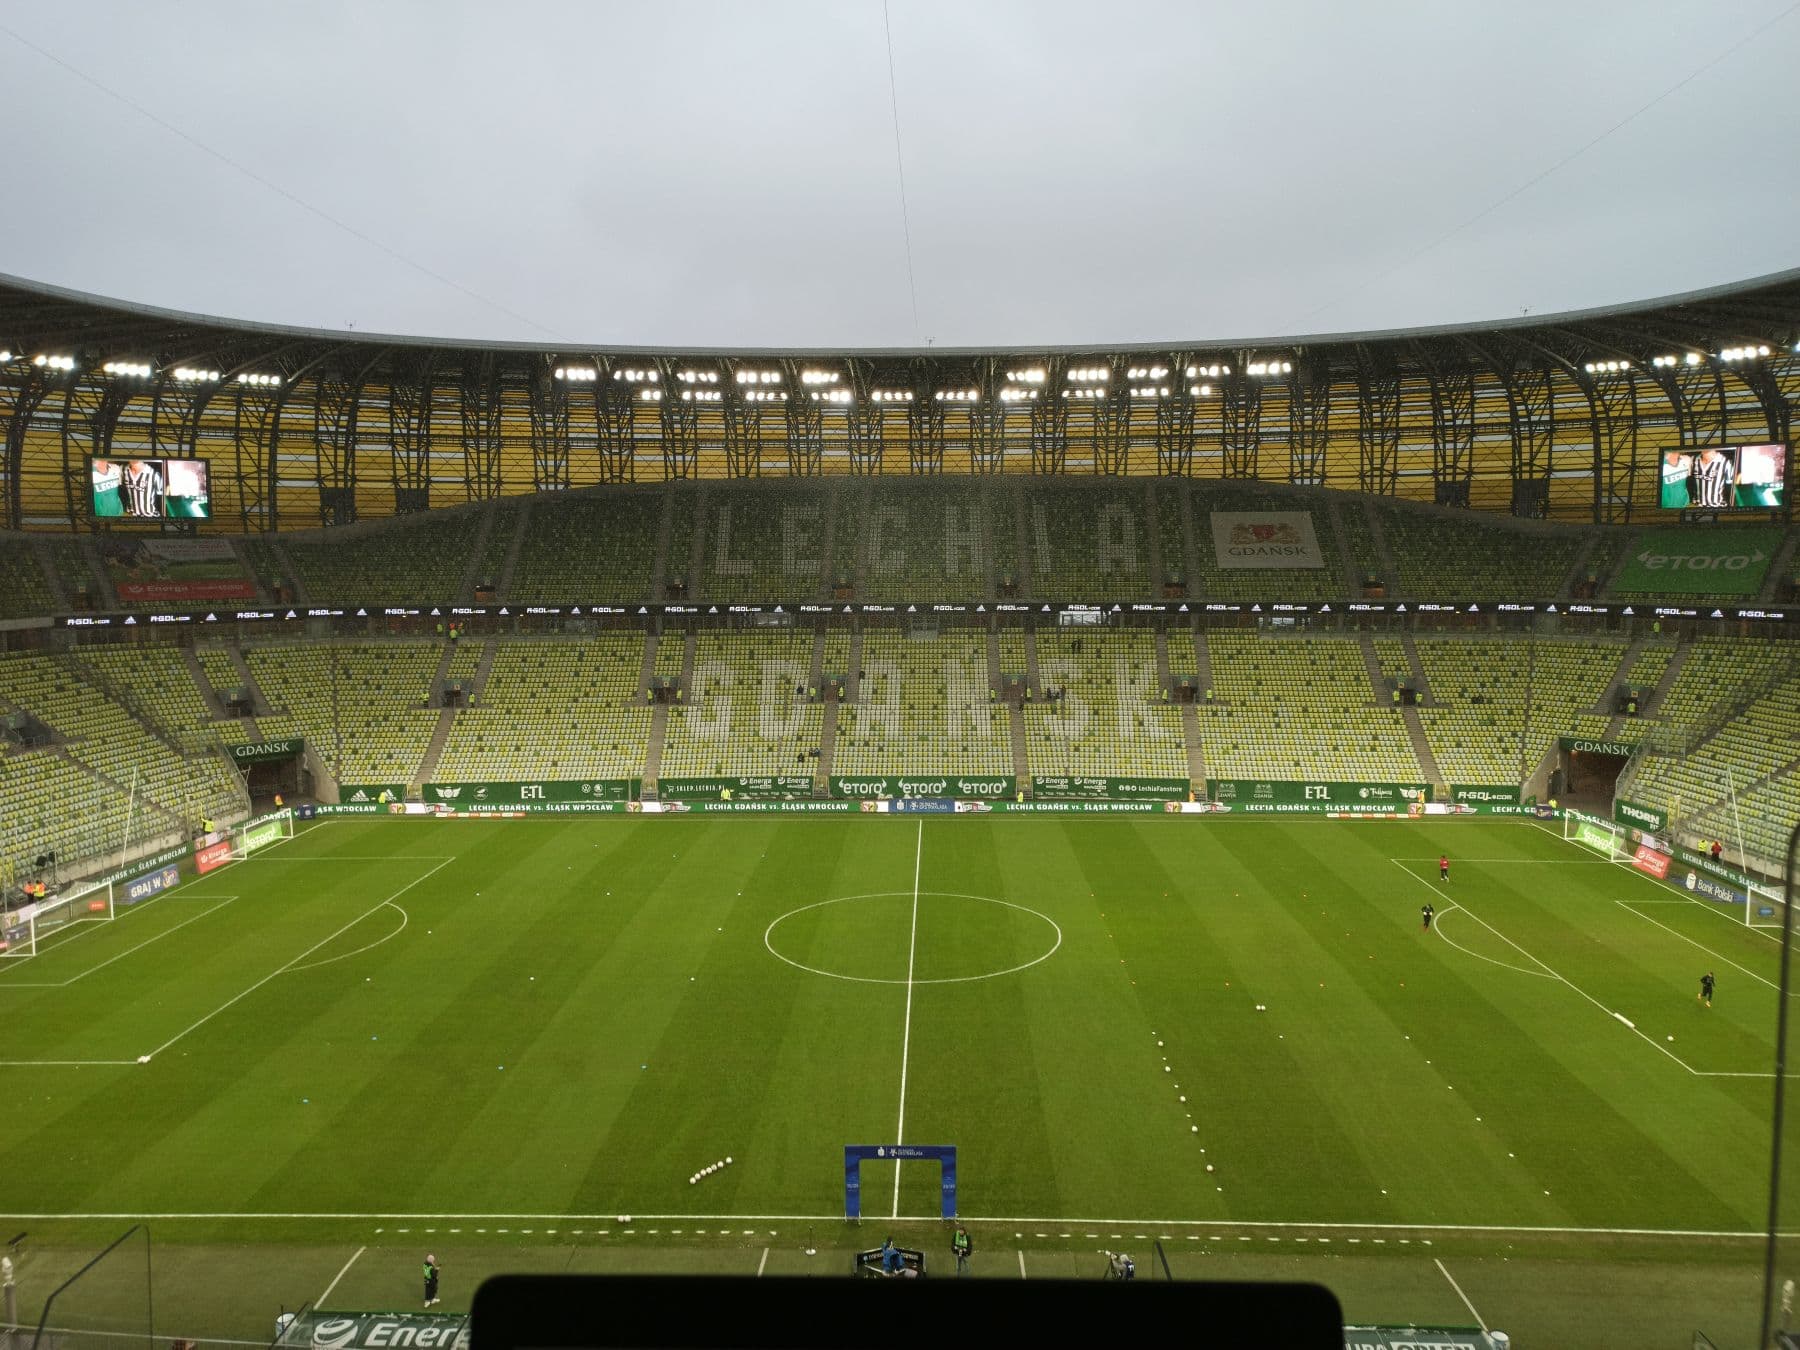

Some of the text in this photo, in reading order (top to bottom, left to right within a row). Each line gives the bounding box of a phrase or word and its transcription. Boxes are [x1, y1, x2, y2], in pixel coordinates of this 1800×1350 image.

[236, 742, 290, 757] GDAŃSK
[1574, 741, 1630, 756] GDAŃSK
[468, 804, 496, 812] LECHIA
[1006, 803, 1034, 811] LECHIA
[131, 881, 152, 898] GRAJ
[1697, 879, 1714, 895] Bank
